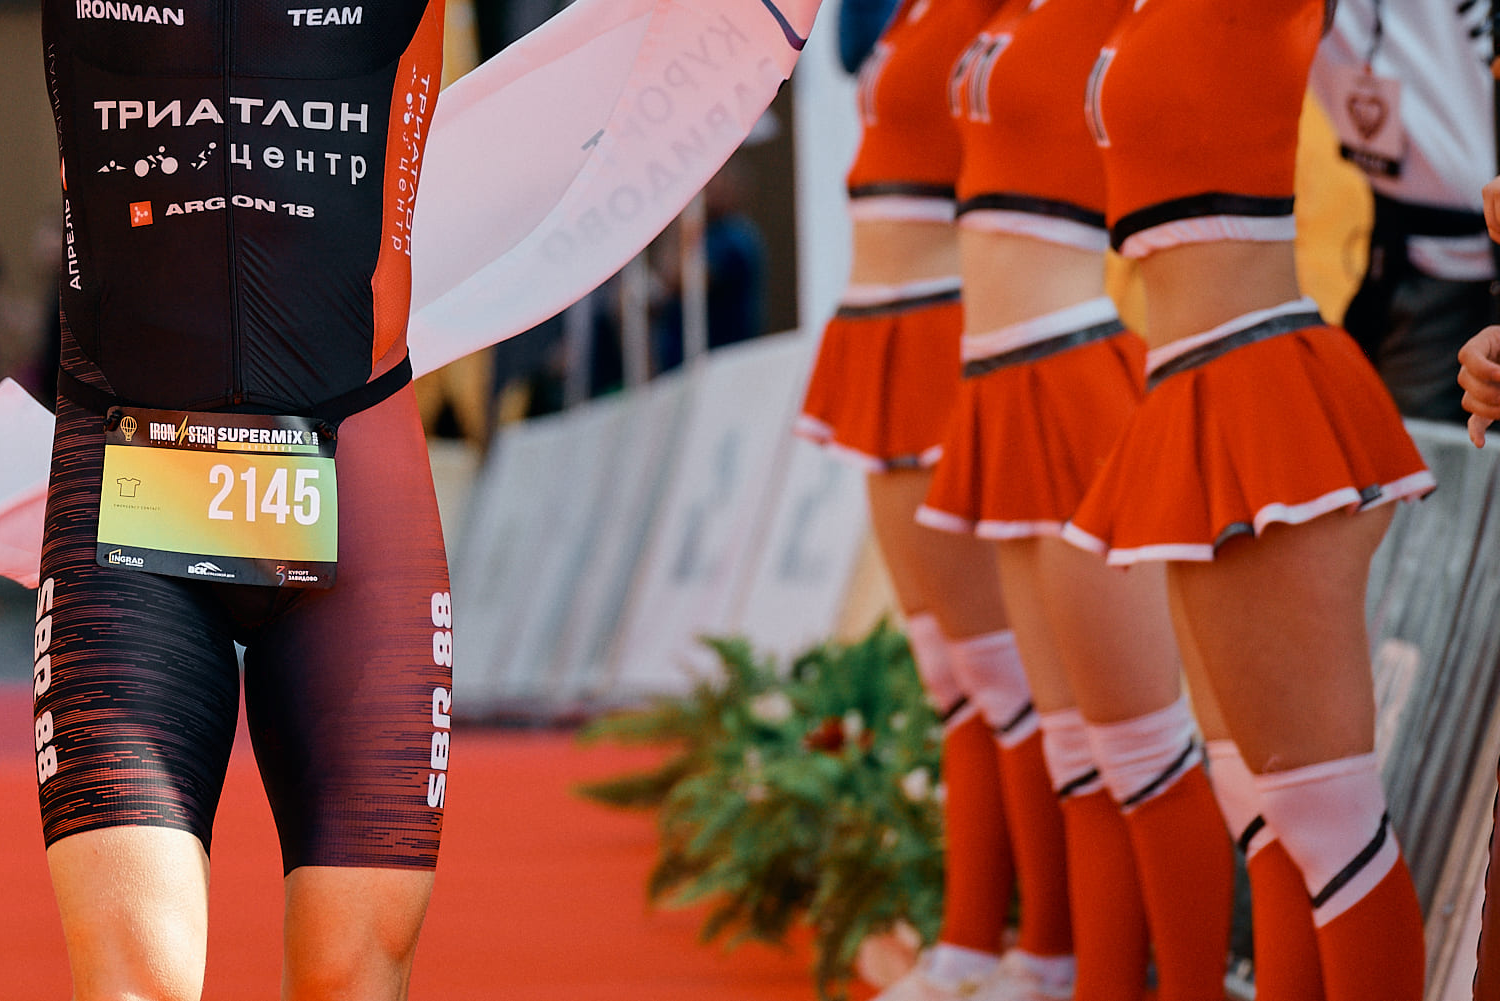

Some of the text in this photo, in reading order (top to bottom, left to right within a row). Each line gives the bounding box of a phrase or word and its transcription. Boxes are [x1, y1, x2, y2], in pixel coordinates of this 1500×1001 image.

[76, 0, 185, 26] IRONMAN
[287, 6, 363, 27] TEAM
[93, 96, 369, 133] ТРИАТЛОН
[230, 142, 368, 185] центр
[165, 194, 316, 219] ARGON 18
[392, 157, 409, 251] центр
[65, 199, 82, 291] АПРЕЛЬ
[150, 422, 176, 442] IRON
[188, 425, 216, 445] STAR
[208, 464, 321, 525] 2145
[111, 554, 144, 565] INGRAD
[33, 577, 58, 785] SBR 88
[427, 591, 453, 809] SBR 88
